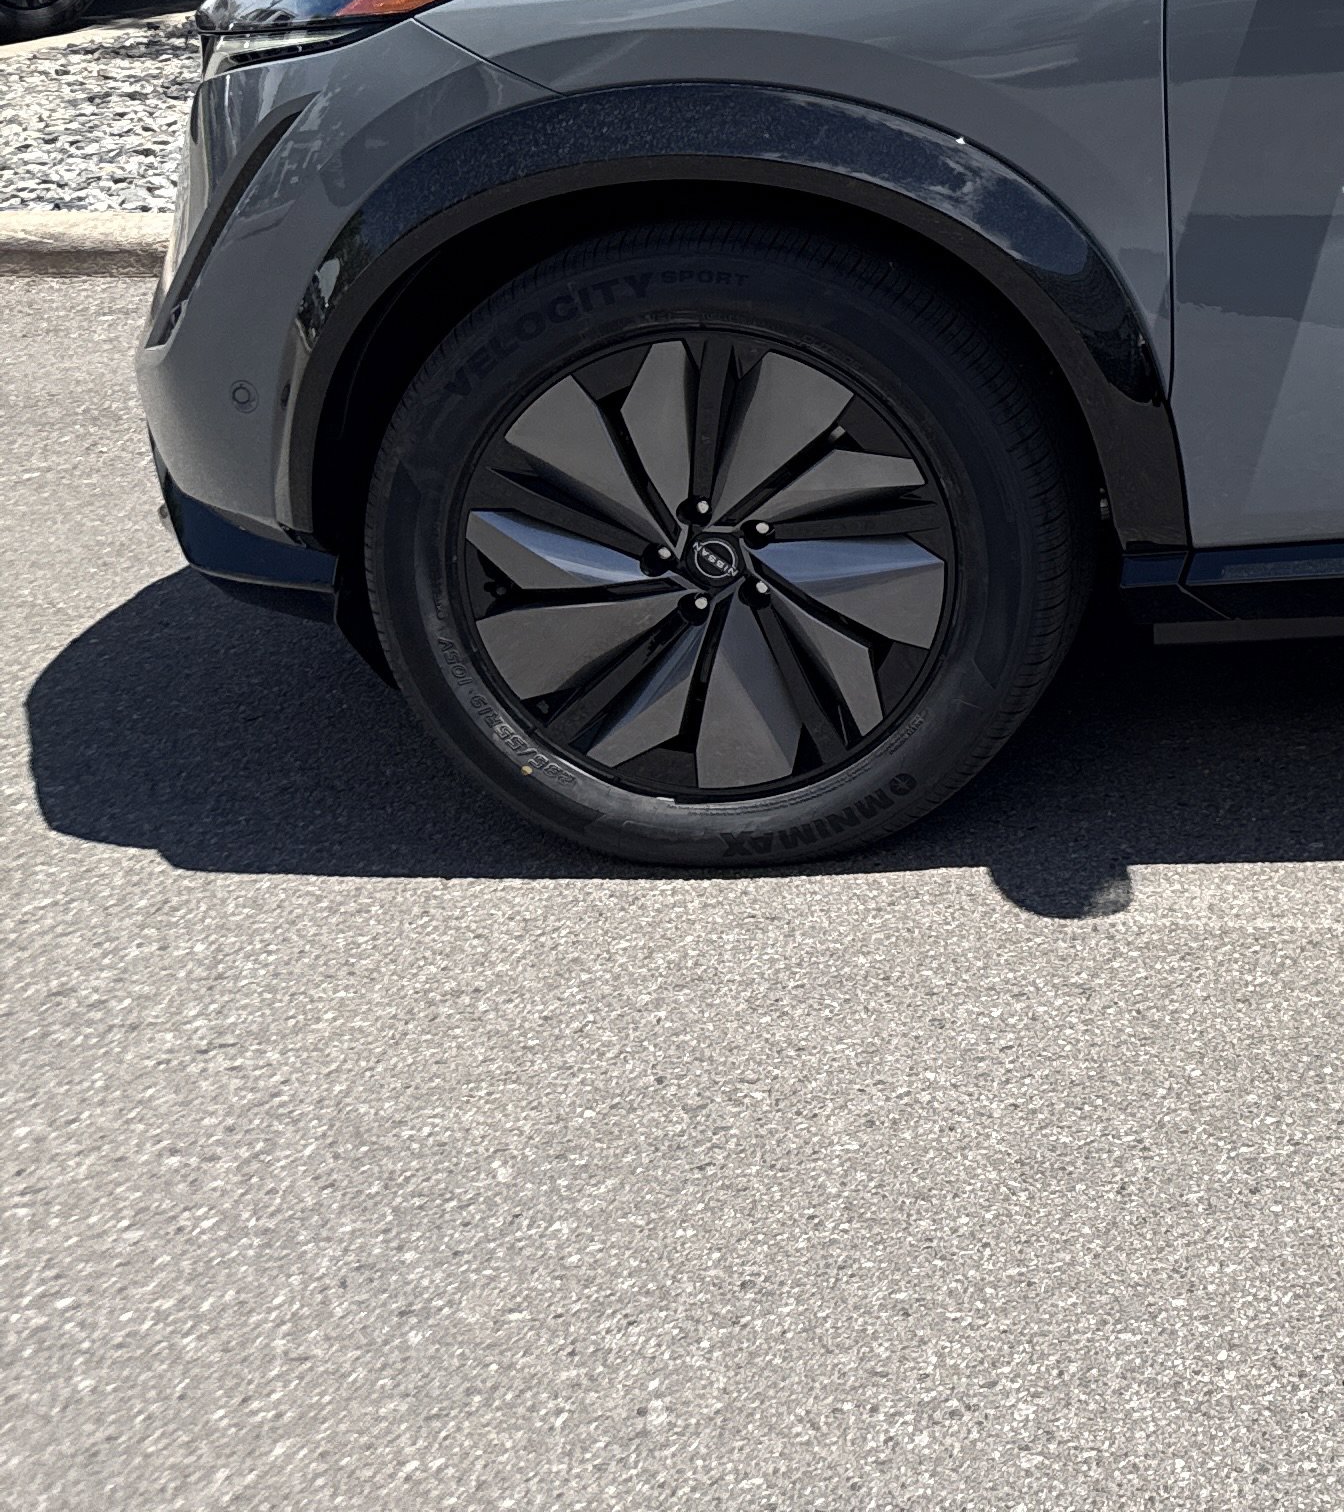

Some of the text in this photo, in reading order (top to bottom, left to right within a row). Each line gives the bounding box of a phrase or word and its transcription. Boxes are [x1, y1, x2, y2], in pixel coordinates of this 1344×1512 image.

[443, 269, 750, 397] VELOCITY SPORT
[692, 541, 739, 577] NISSAN
[720, 772, 918, 858] OMNIMAX
